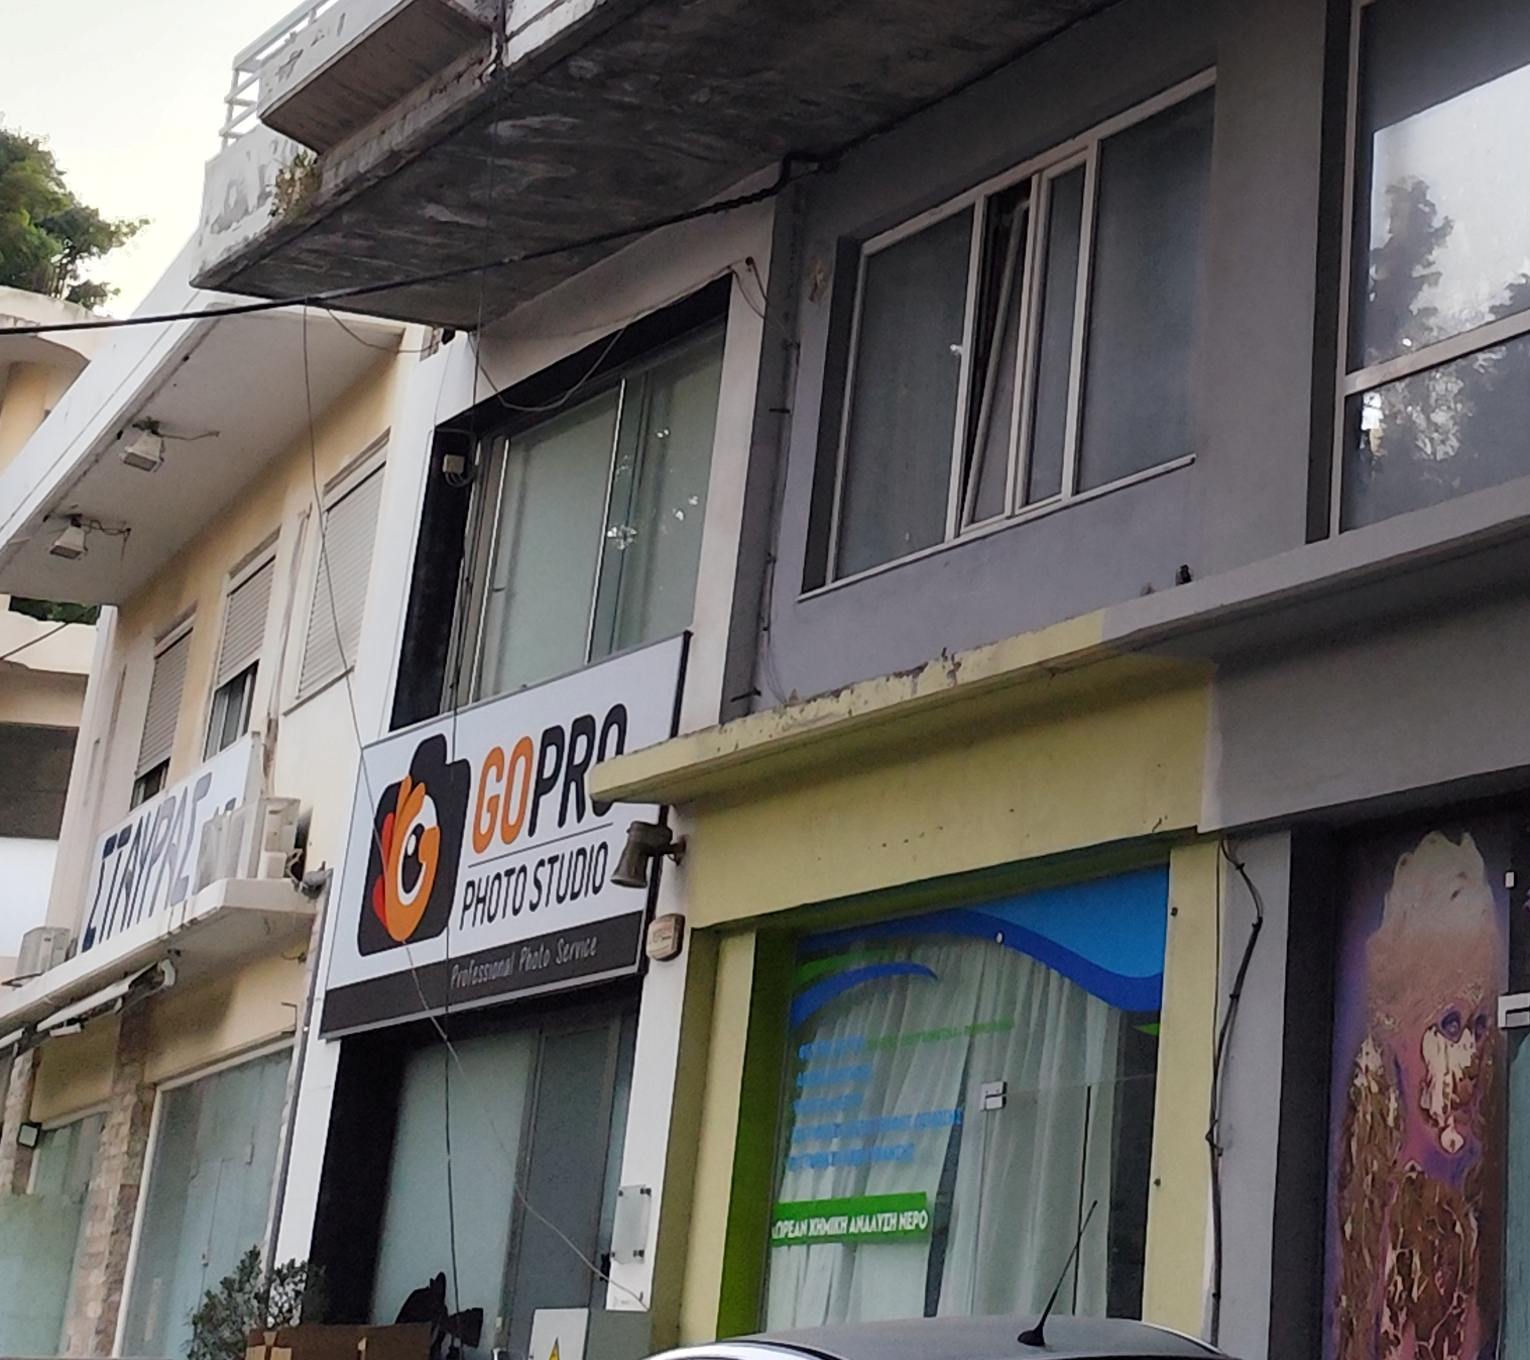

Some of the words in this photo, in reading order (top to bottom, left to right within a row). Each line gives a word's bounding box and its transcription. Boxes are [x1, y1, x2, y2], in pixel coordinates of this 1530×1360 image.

[472, 703, 628, 855] GOPRO
[459, 864, 528, 931] PHOTO
[529, 841, 609, 913] STUDIO
[518, 943, 550, 972] Photo
[555, 935, 598, 965] Service
